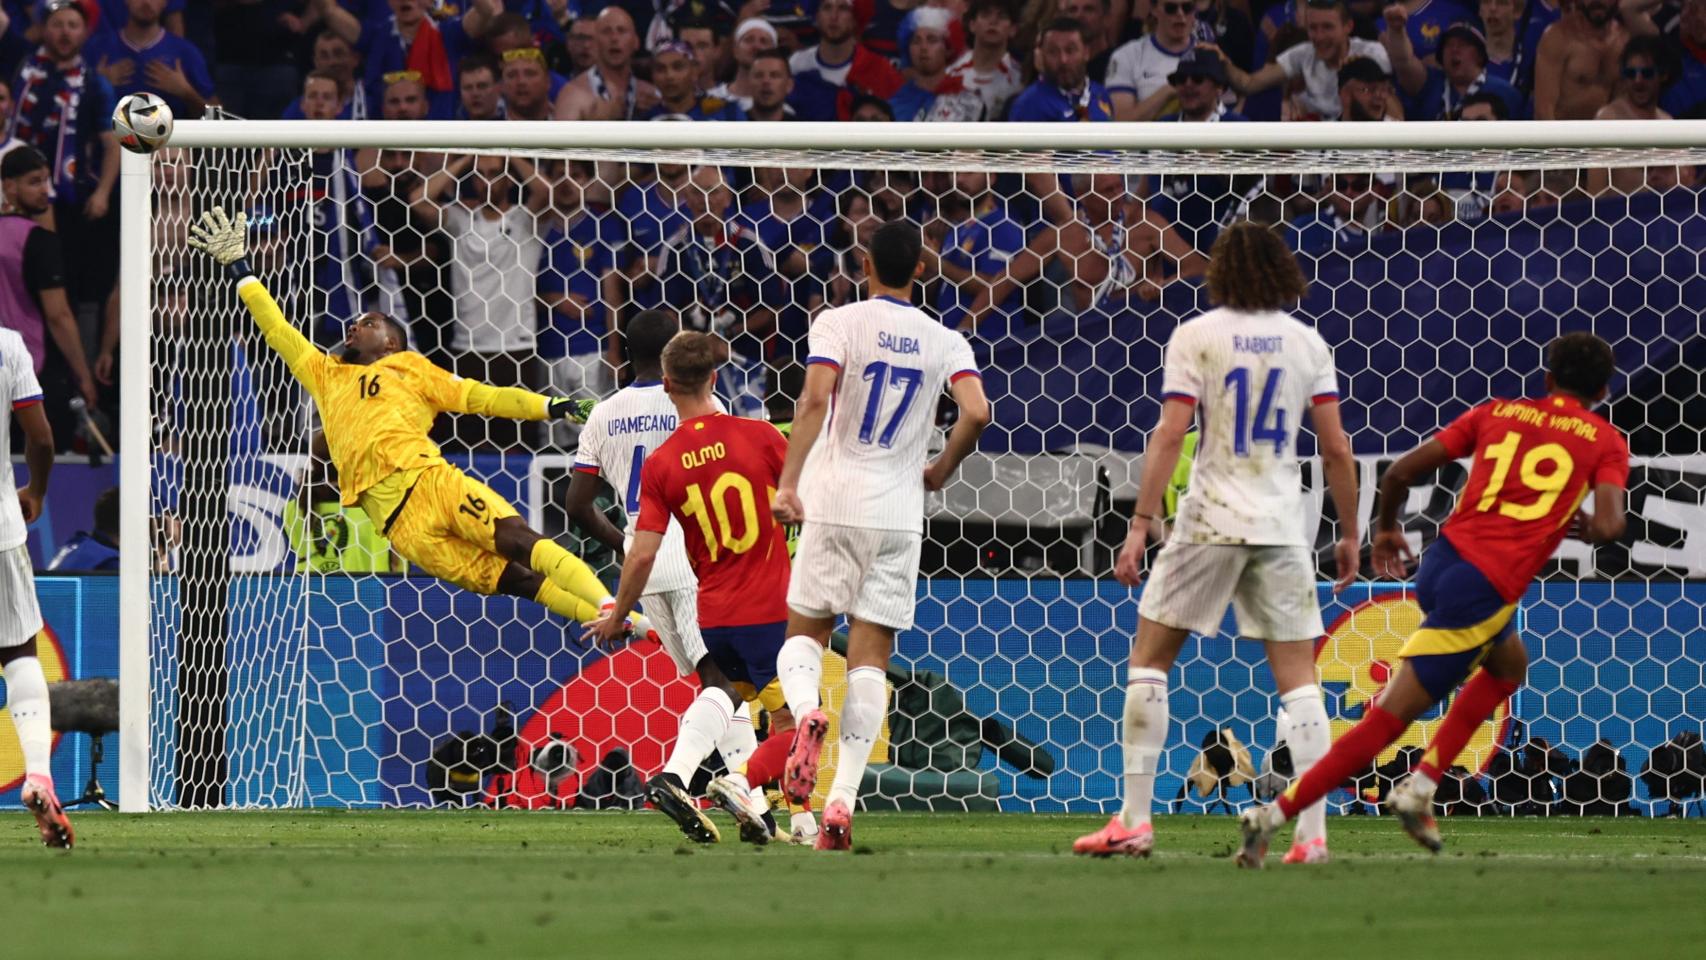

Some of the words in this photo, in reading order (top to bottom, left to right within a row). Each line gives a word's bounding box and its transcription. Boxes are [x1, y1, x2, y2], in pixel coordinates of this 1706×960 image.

[877, 331, 921, 356] SALIBA
[1232, 335, 1284, 354] RABIOT
[358, 374, 382, 399] 16
[858, 360, 925, 450] 17
[1224, 366, 1290, 459] 14
[608, 414, 677, 437] UPAMECANO
[1491, 401, 1549, 428] LAMINE
[1549, 414, 1599, 443] YAMAL
[681, 441, 726, 470] OLMO
[1476, 430, 1575, 522] 19
[458, 493, 488, 521] 16
[680, 471, 760, 563] 10
